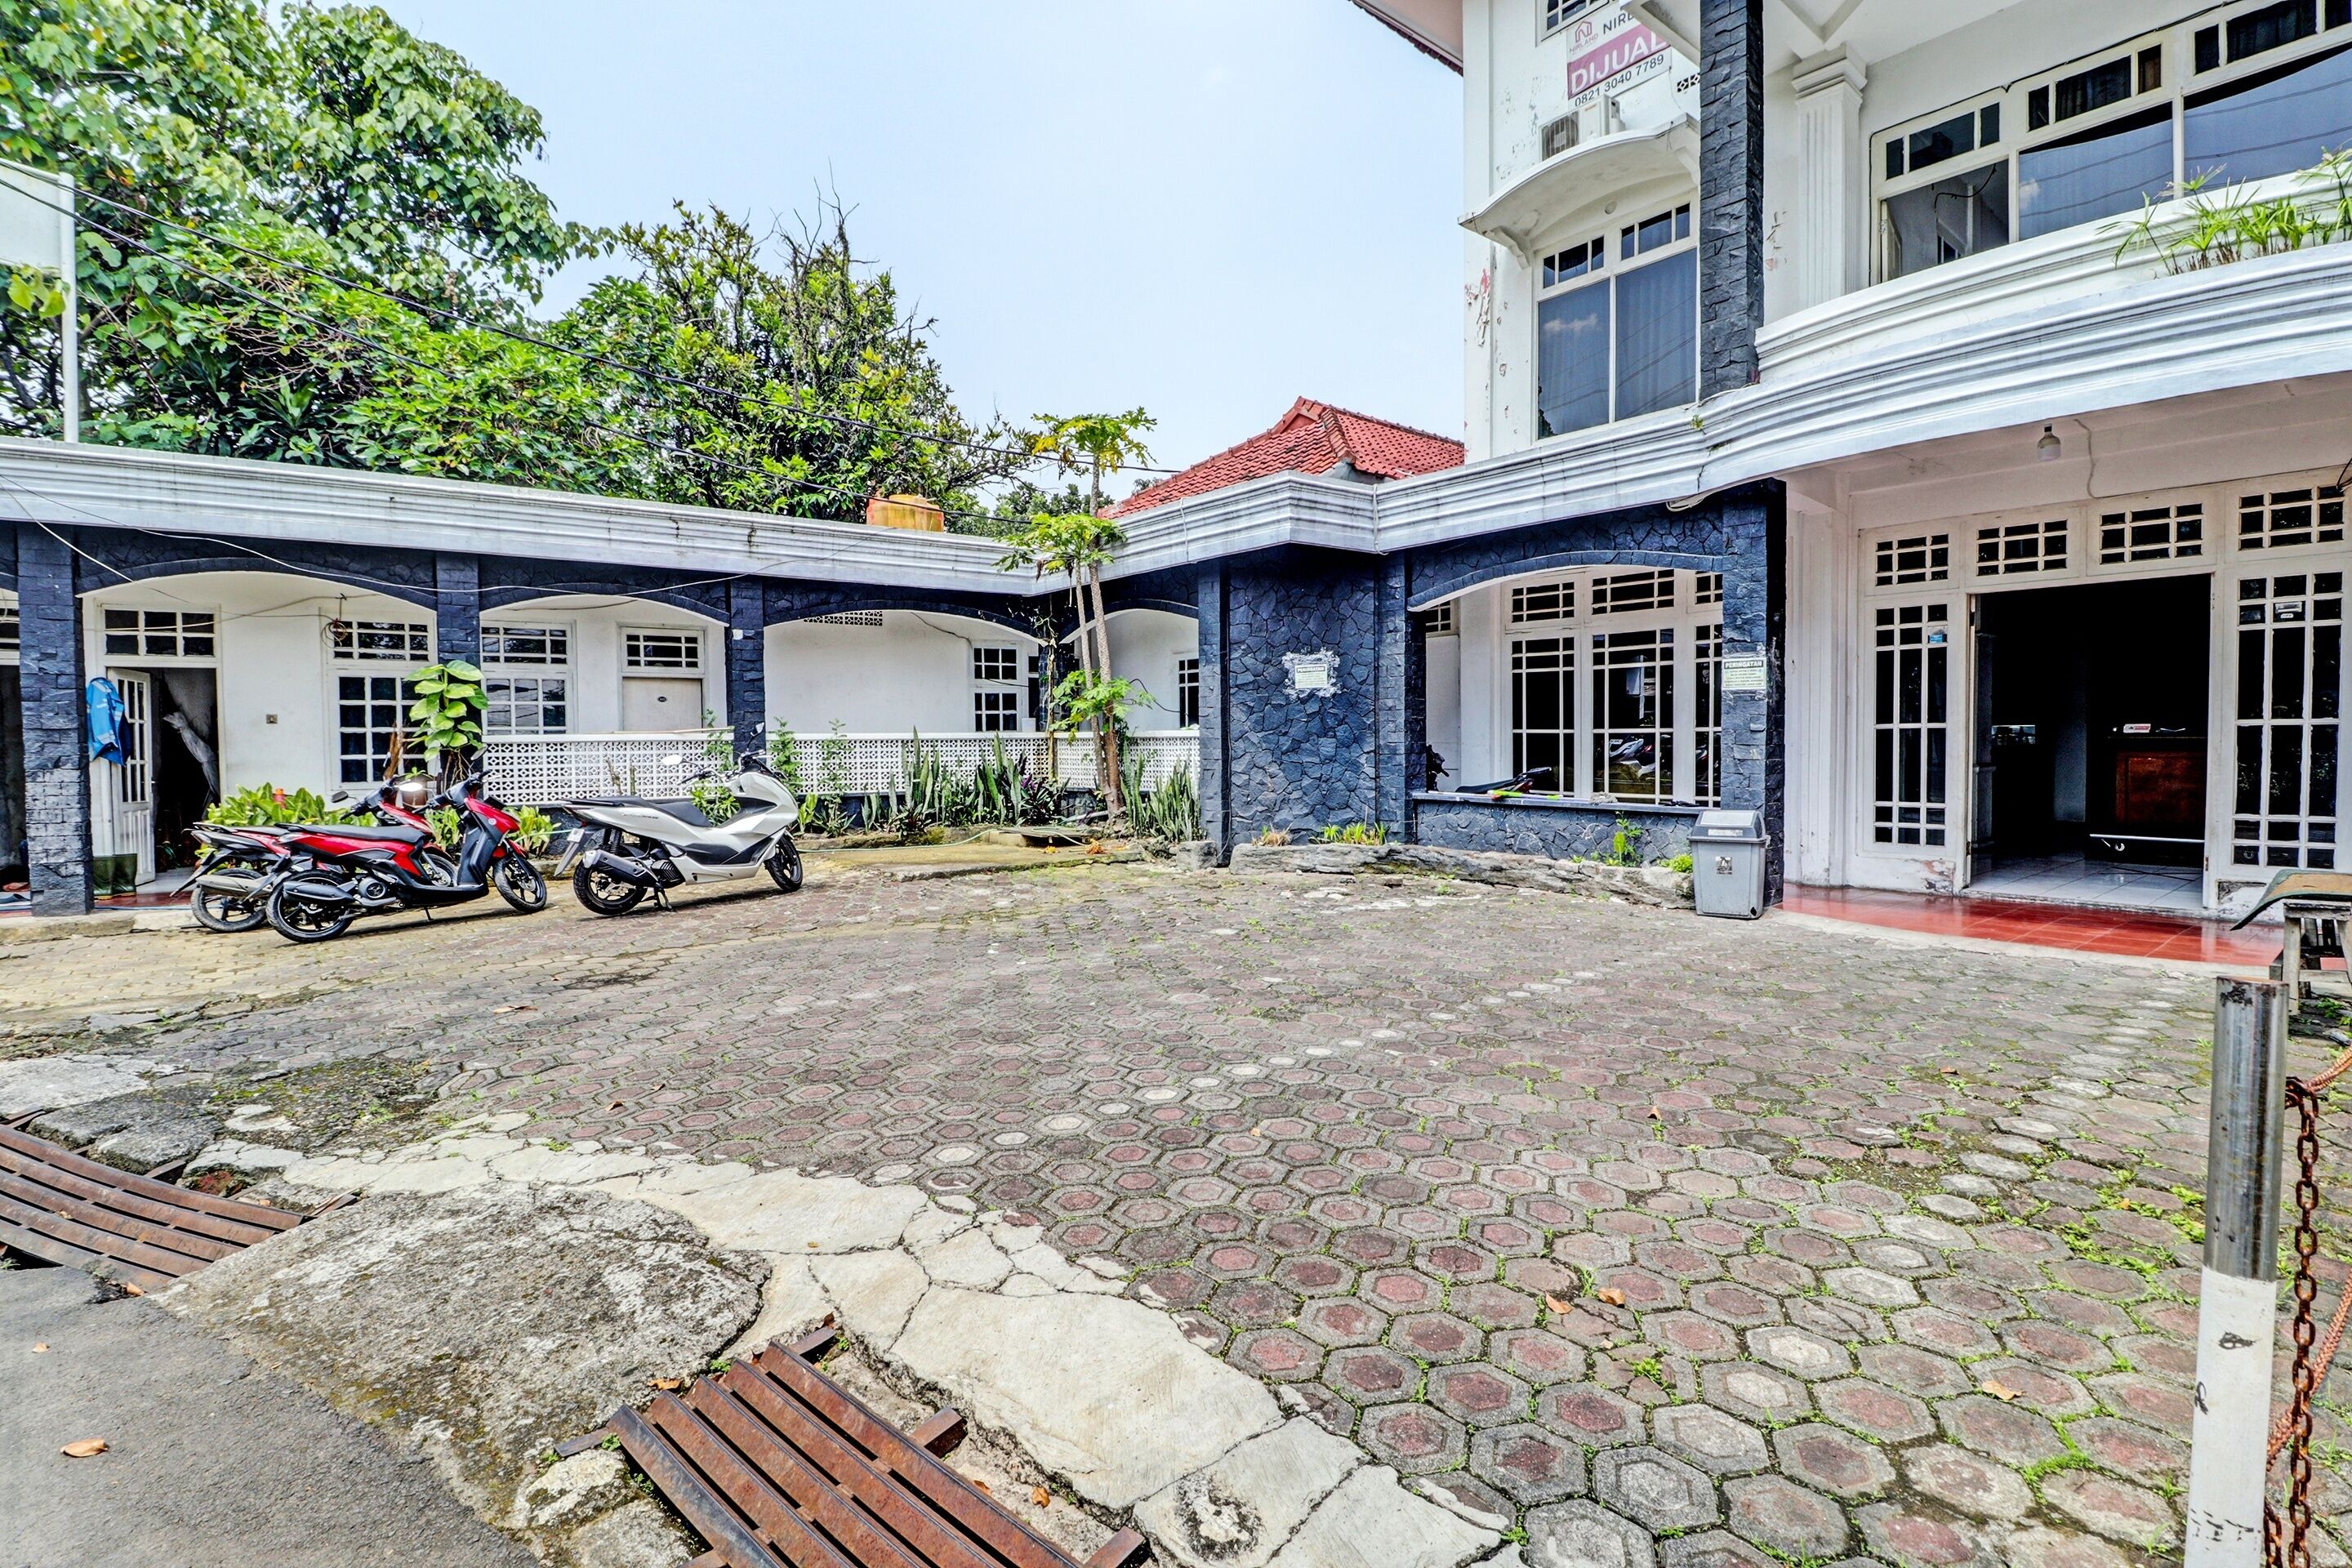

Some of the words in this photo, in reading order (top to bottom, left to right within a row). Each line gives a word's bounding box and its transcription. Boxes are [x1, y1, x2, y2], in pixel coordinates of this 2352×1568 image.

[1570, 31, 1667, 94] DIJUAL
[1575, 87, 1601, 107] 0821
[1604, 70, 1632, 92] 3040
[1635, 54, 1664, 76] 7789
